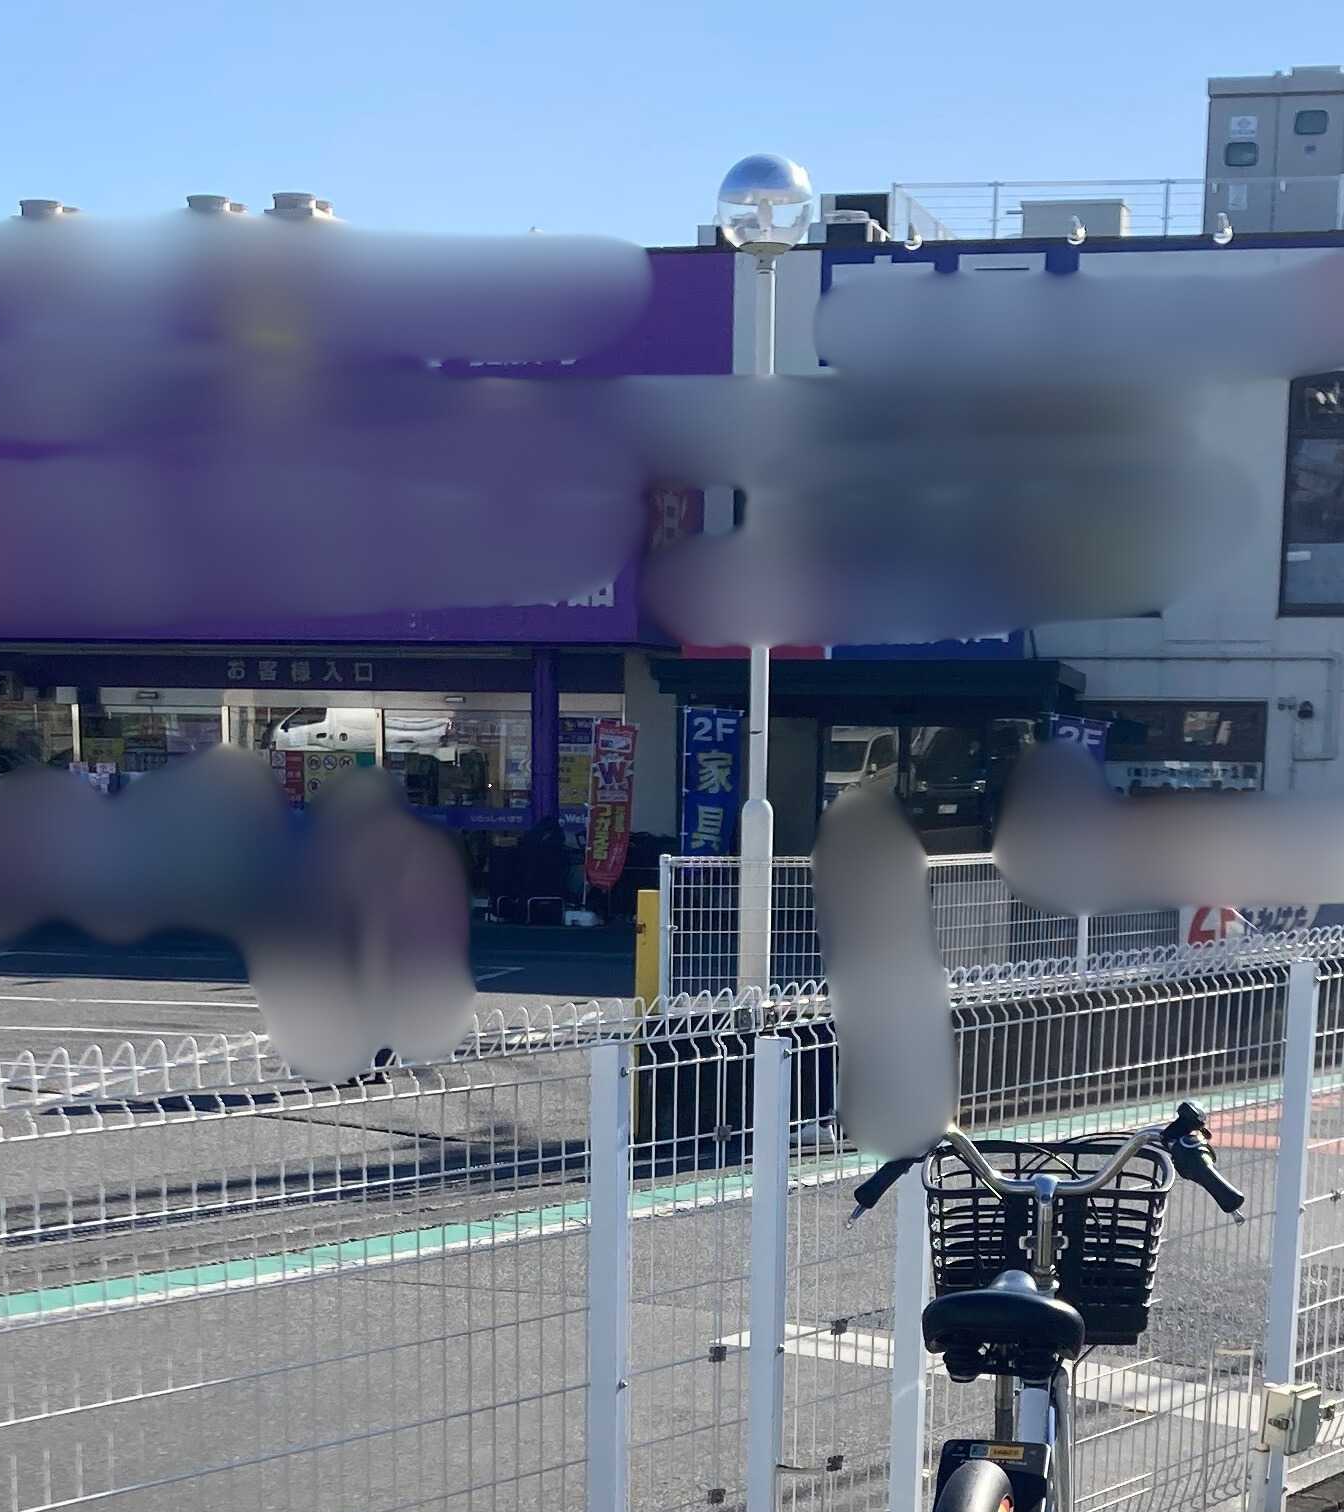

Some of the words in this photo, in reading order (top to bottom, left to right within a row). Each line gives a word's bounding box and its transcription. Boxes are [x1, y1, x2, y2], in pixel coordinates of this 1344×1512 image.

[227, 658, 374, 682] お客様入口
[693, 717, 737, 742] 2F
[691, 750, 733, 850] 家具
